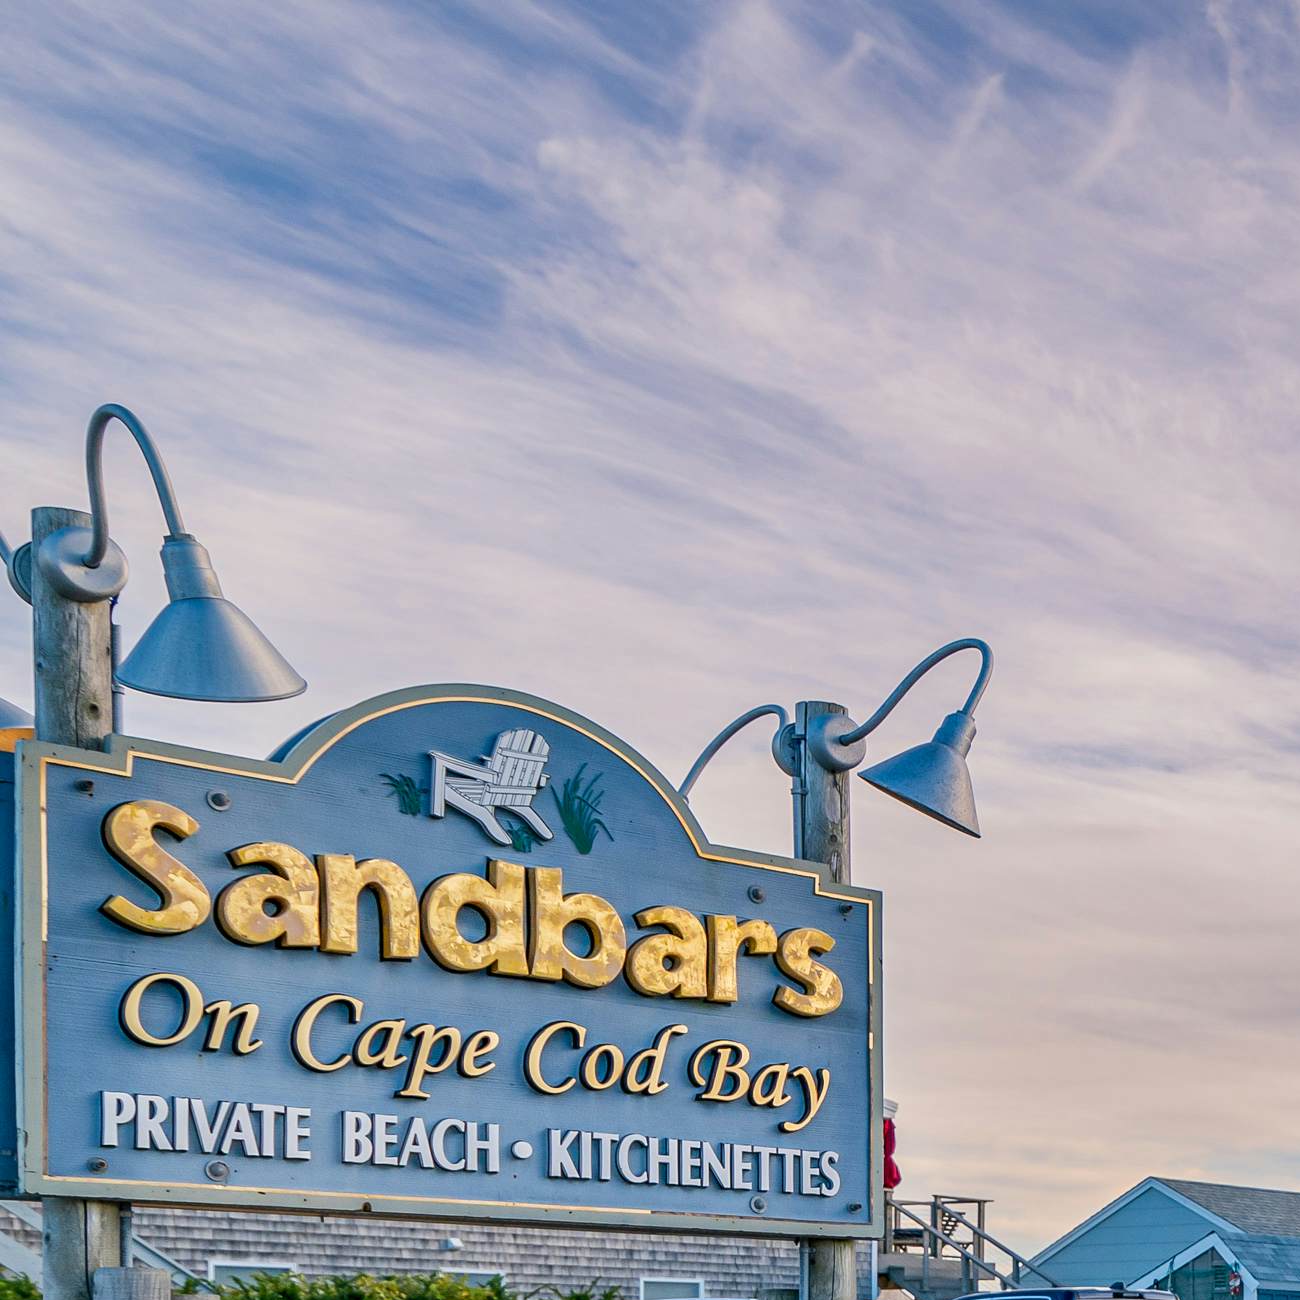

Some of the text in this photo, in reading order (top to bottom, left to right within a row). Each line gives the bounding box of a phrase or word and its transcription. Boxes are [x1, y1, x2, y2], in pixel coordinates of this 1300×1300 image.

[101, 799, 844, 1018] Sandbars
[119, 972, 830, 1133] On Cape Cod Bay
[100, 1090, 842, 1197] PRIVATE BEACH KITCHENETTES
